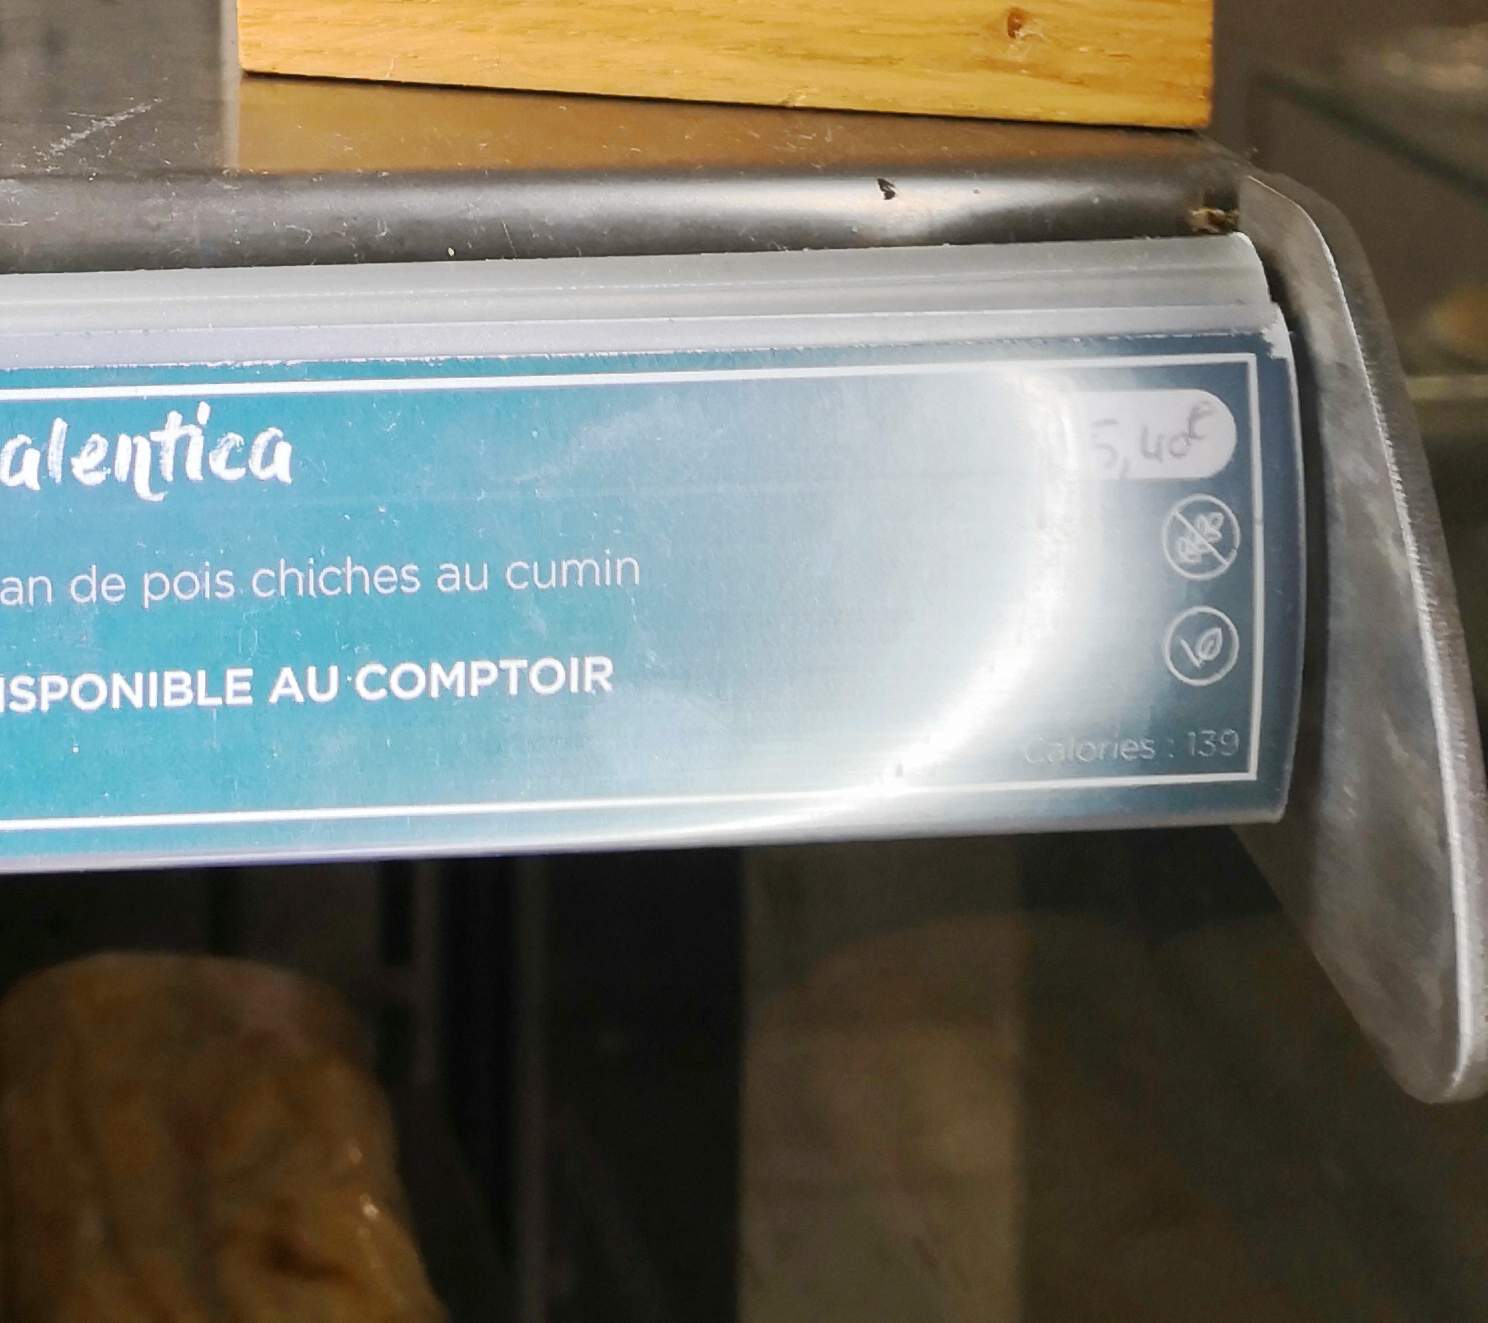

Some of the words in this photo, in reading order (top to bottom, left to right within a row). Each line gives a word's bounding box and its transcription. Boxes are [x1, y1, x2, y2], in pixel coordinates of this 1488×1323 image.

[69, 563, 126, 604] de
[143, 560, 235, 609] pois
[251, 557, 420, 600] chiches
[436, 565, 489, 593] au
[505, 551, 642, 591] cumin
[269, 663, 342, 704] AU
[355, 655, 614, 702] COMPTOIR
[1022, 733, 1158, 765] Calories
